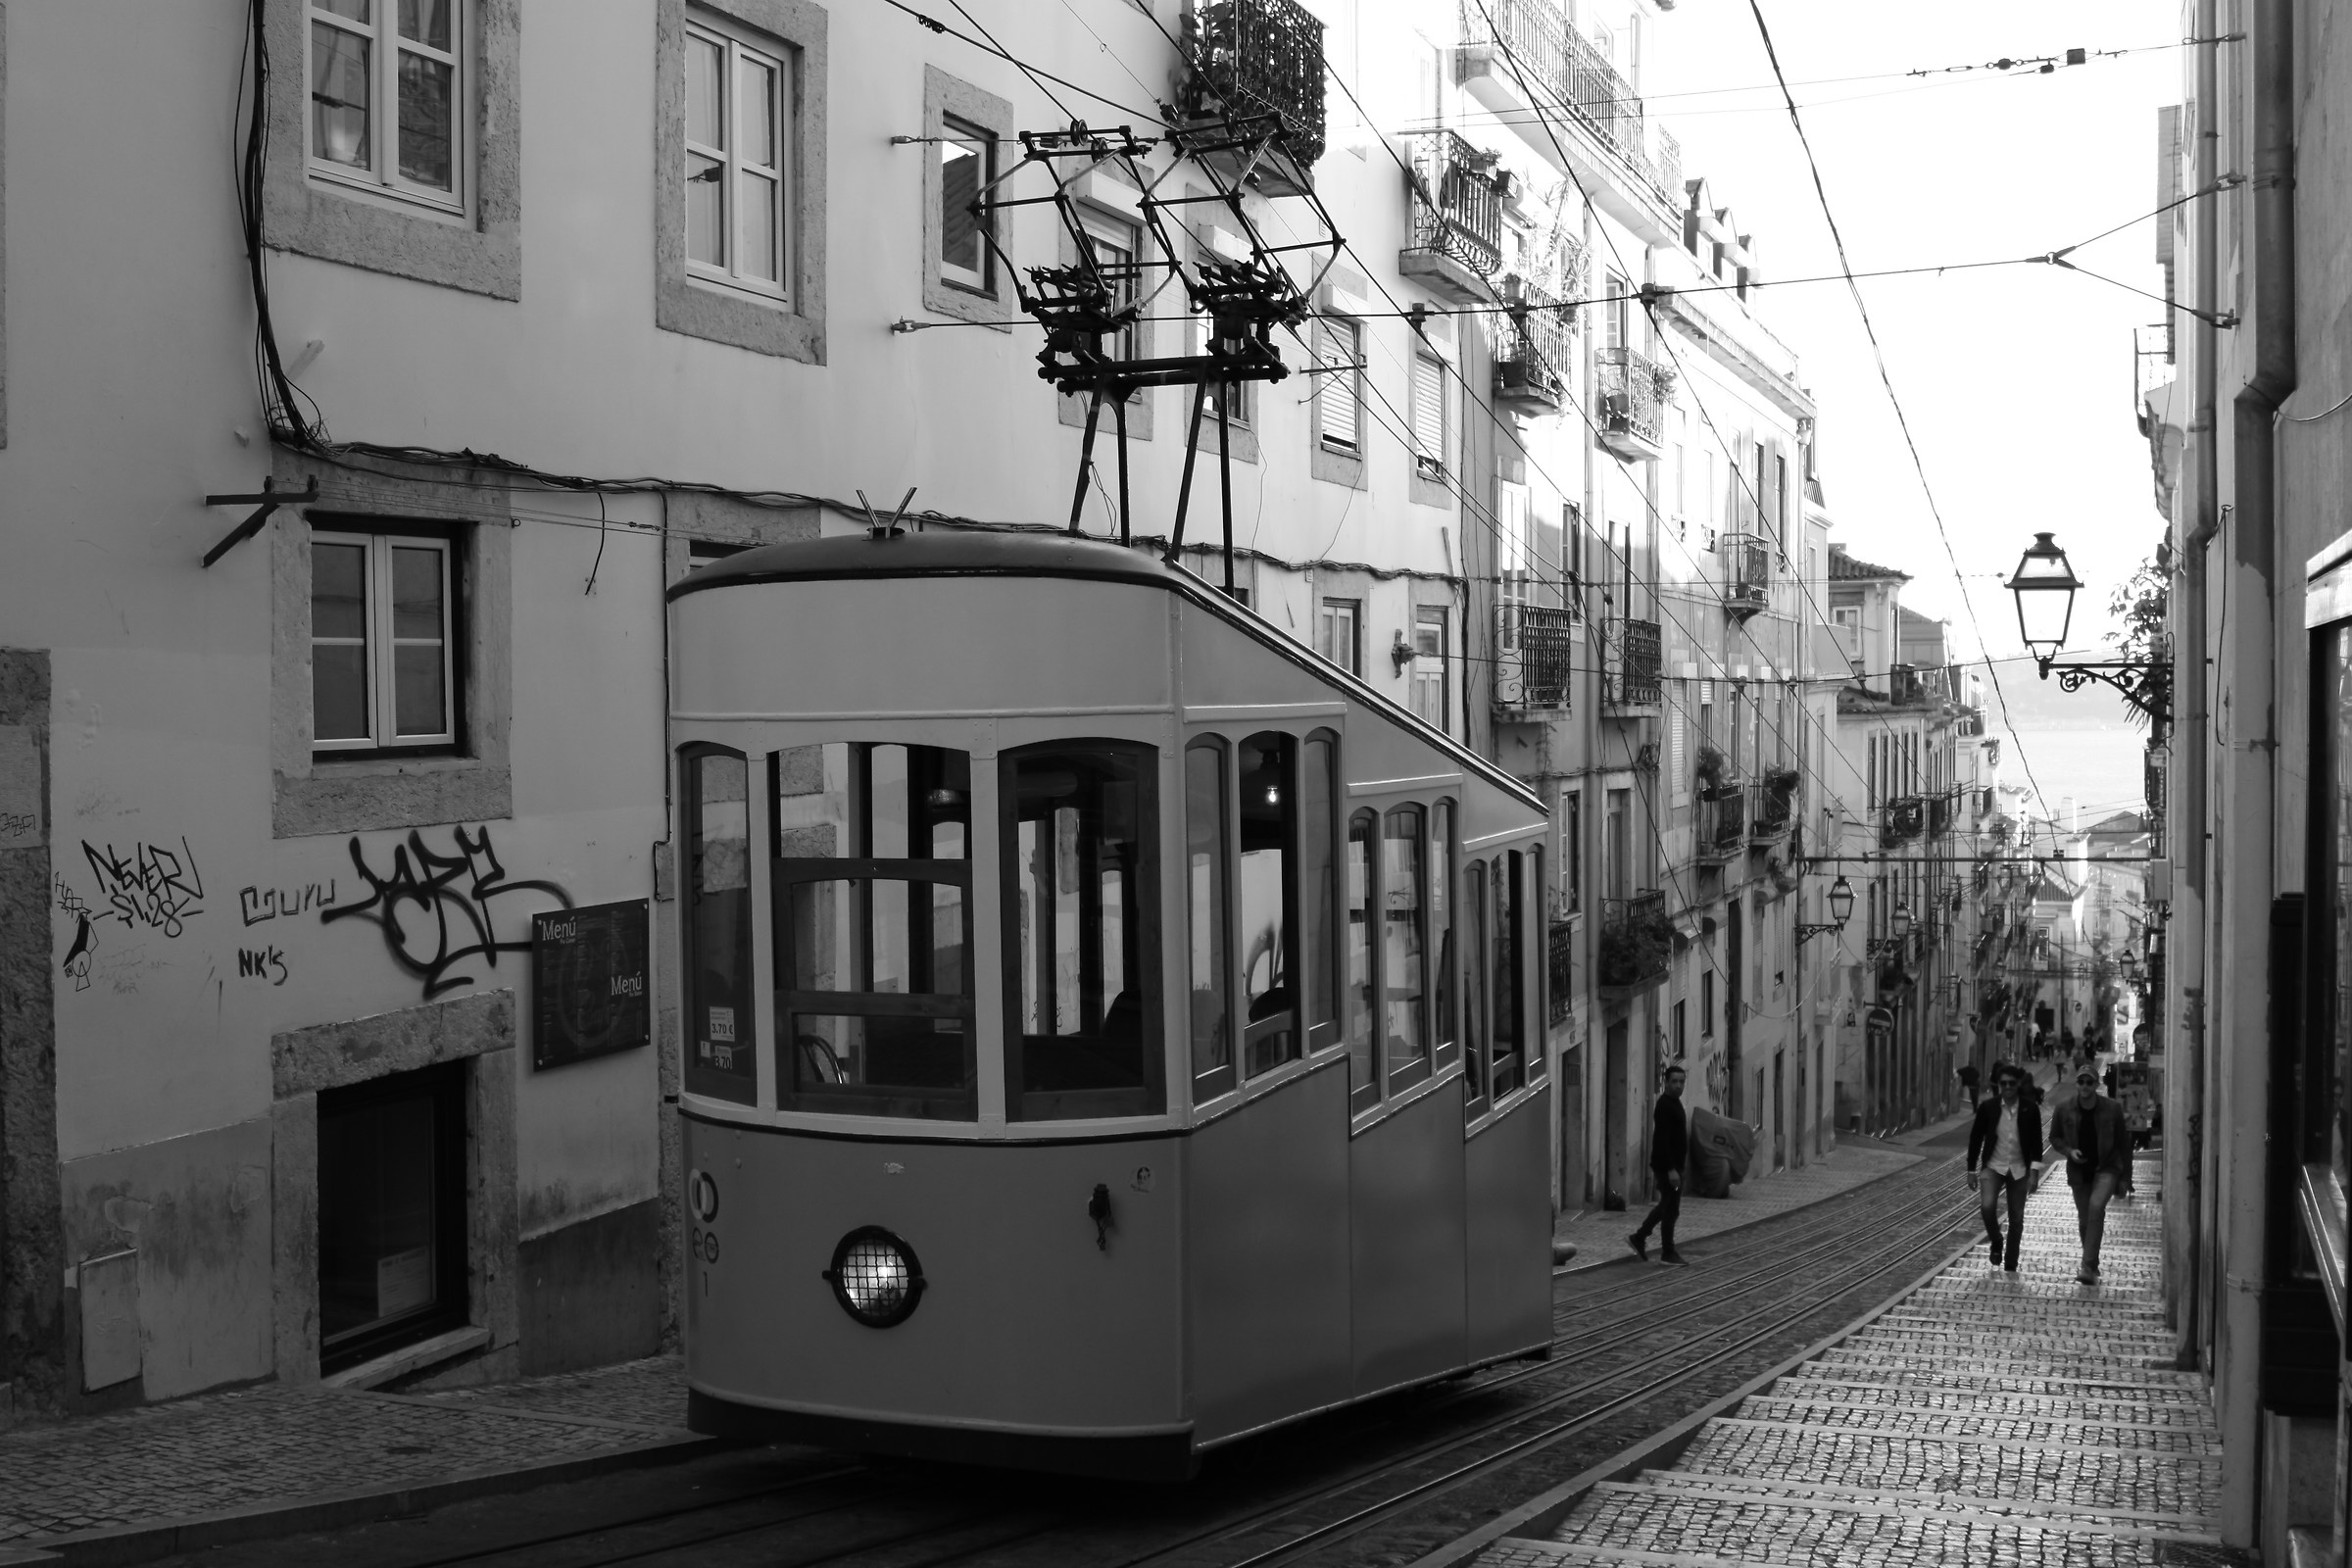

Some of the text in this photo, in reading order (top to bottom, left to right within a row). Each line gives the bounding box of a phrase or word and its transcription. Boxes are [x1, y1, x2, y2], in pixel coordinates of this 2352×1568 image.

[542, 915, 576, 942] Menú
[611, 971, 642, 996] Menú
[711, 1023, 727, 1035] 3.70
[713, 1055, 731, 1070] 3.70
